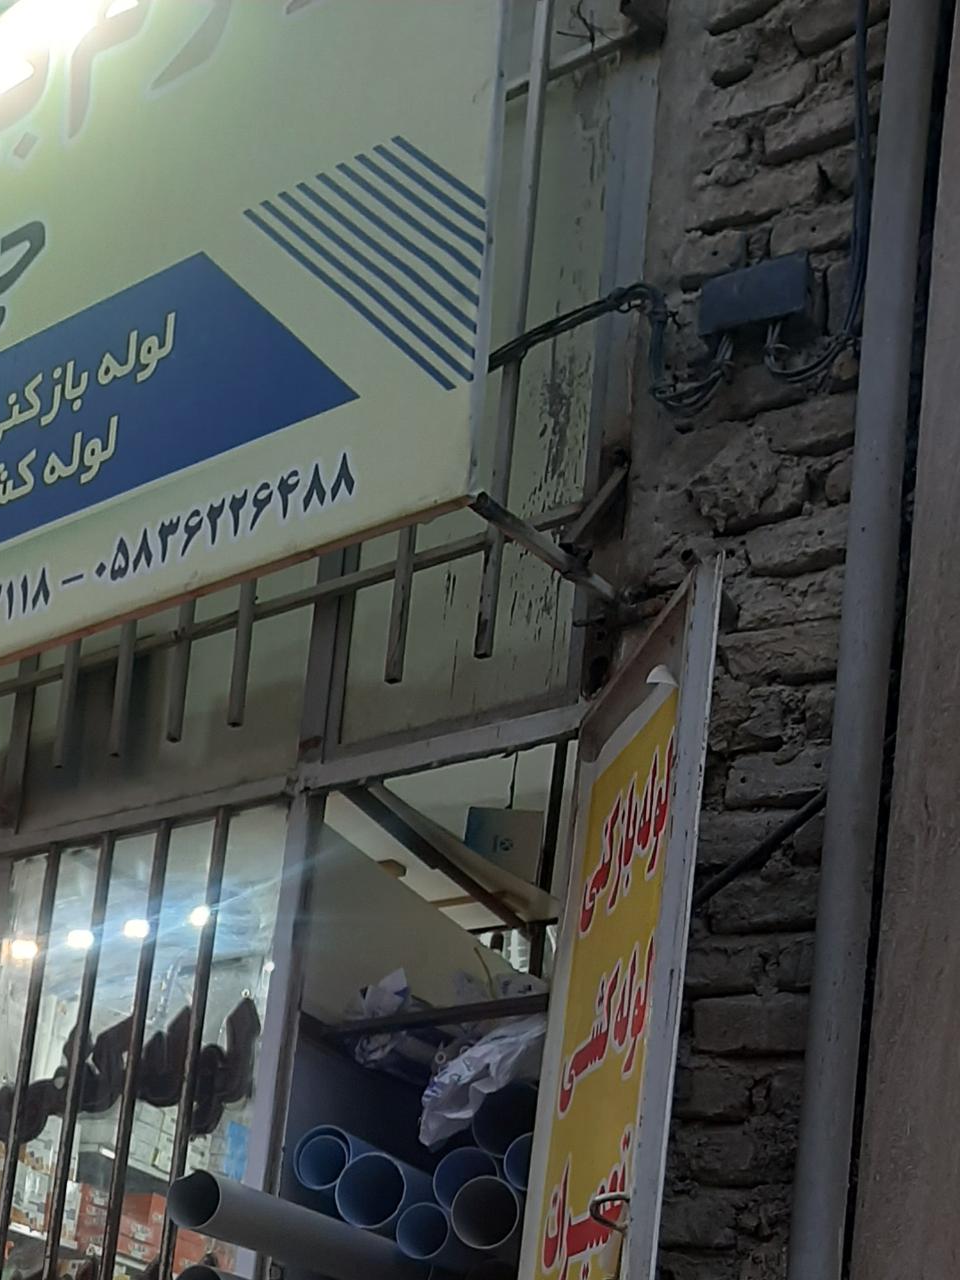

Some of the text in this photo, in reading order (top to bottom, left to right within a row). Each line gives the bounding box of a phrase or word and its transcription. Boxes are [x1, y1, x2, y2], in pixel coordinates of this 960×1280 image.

[97, 312, 177, 387] لوله
[44, 414, 119, 484] لوله
[93, 450, 356, 583] ۰۵۸۳۶۲۲۶۴۸۸
[636, 727, 676, 874] لوله
[559, 933, 656, 1119] لوله کشی
